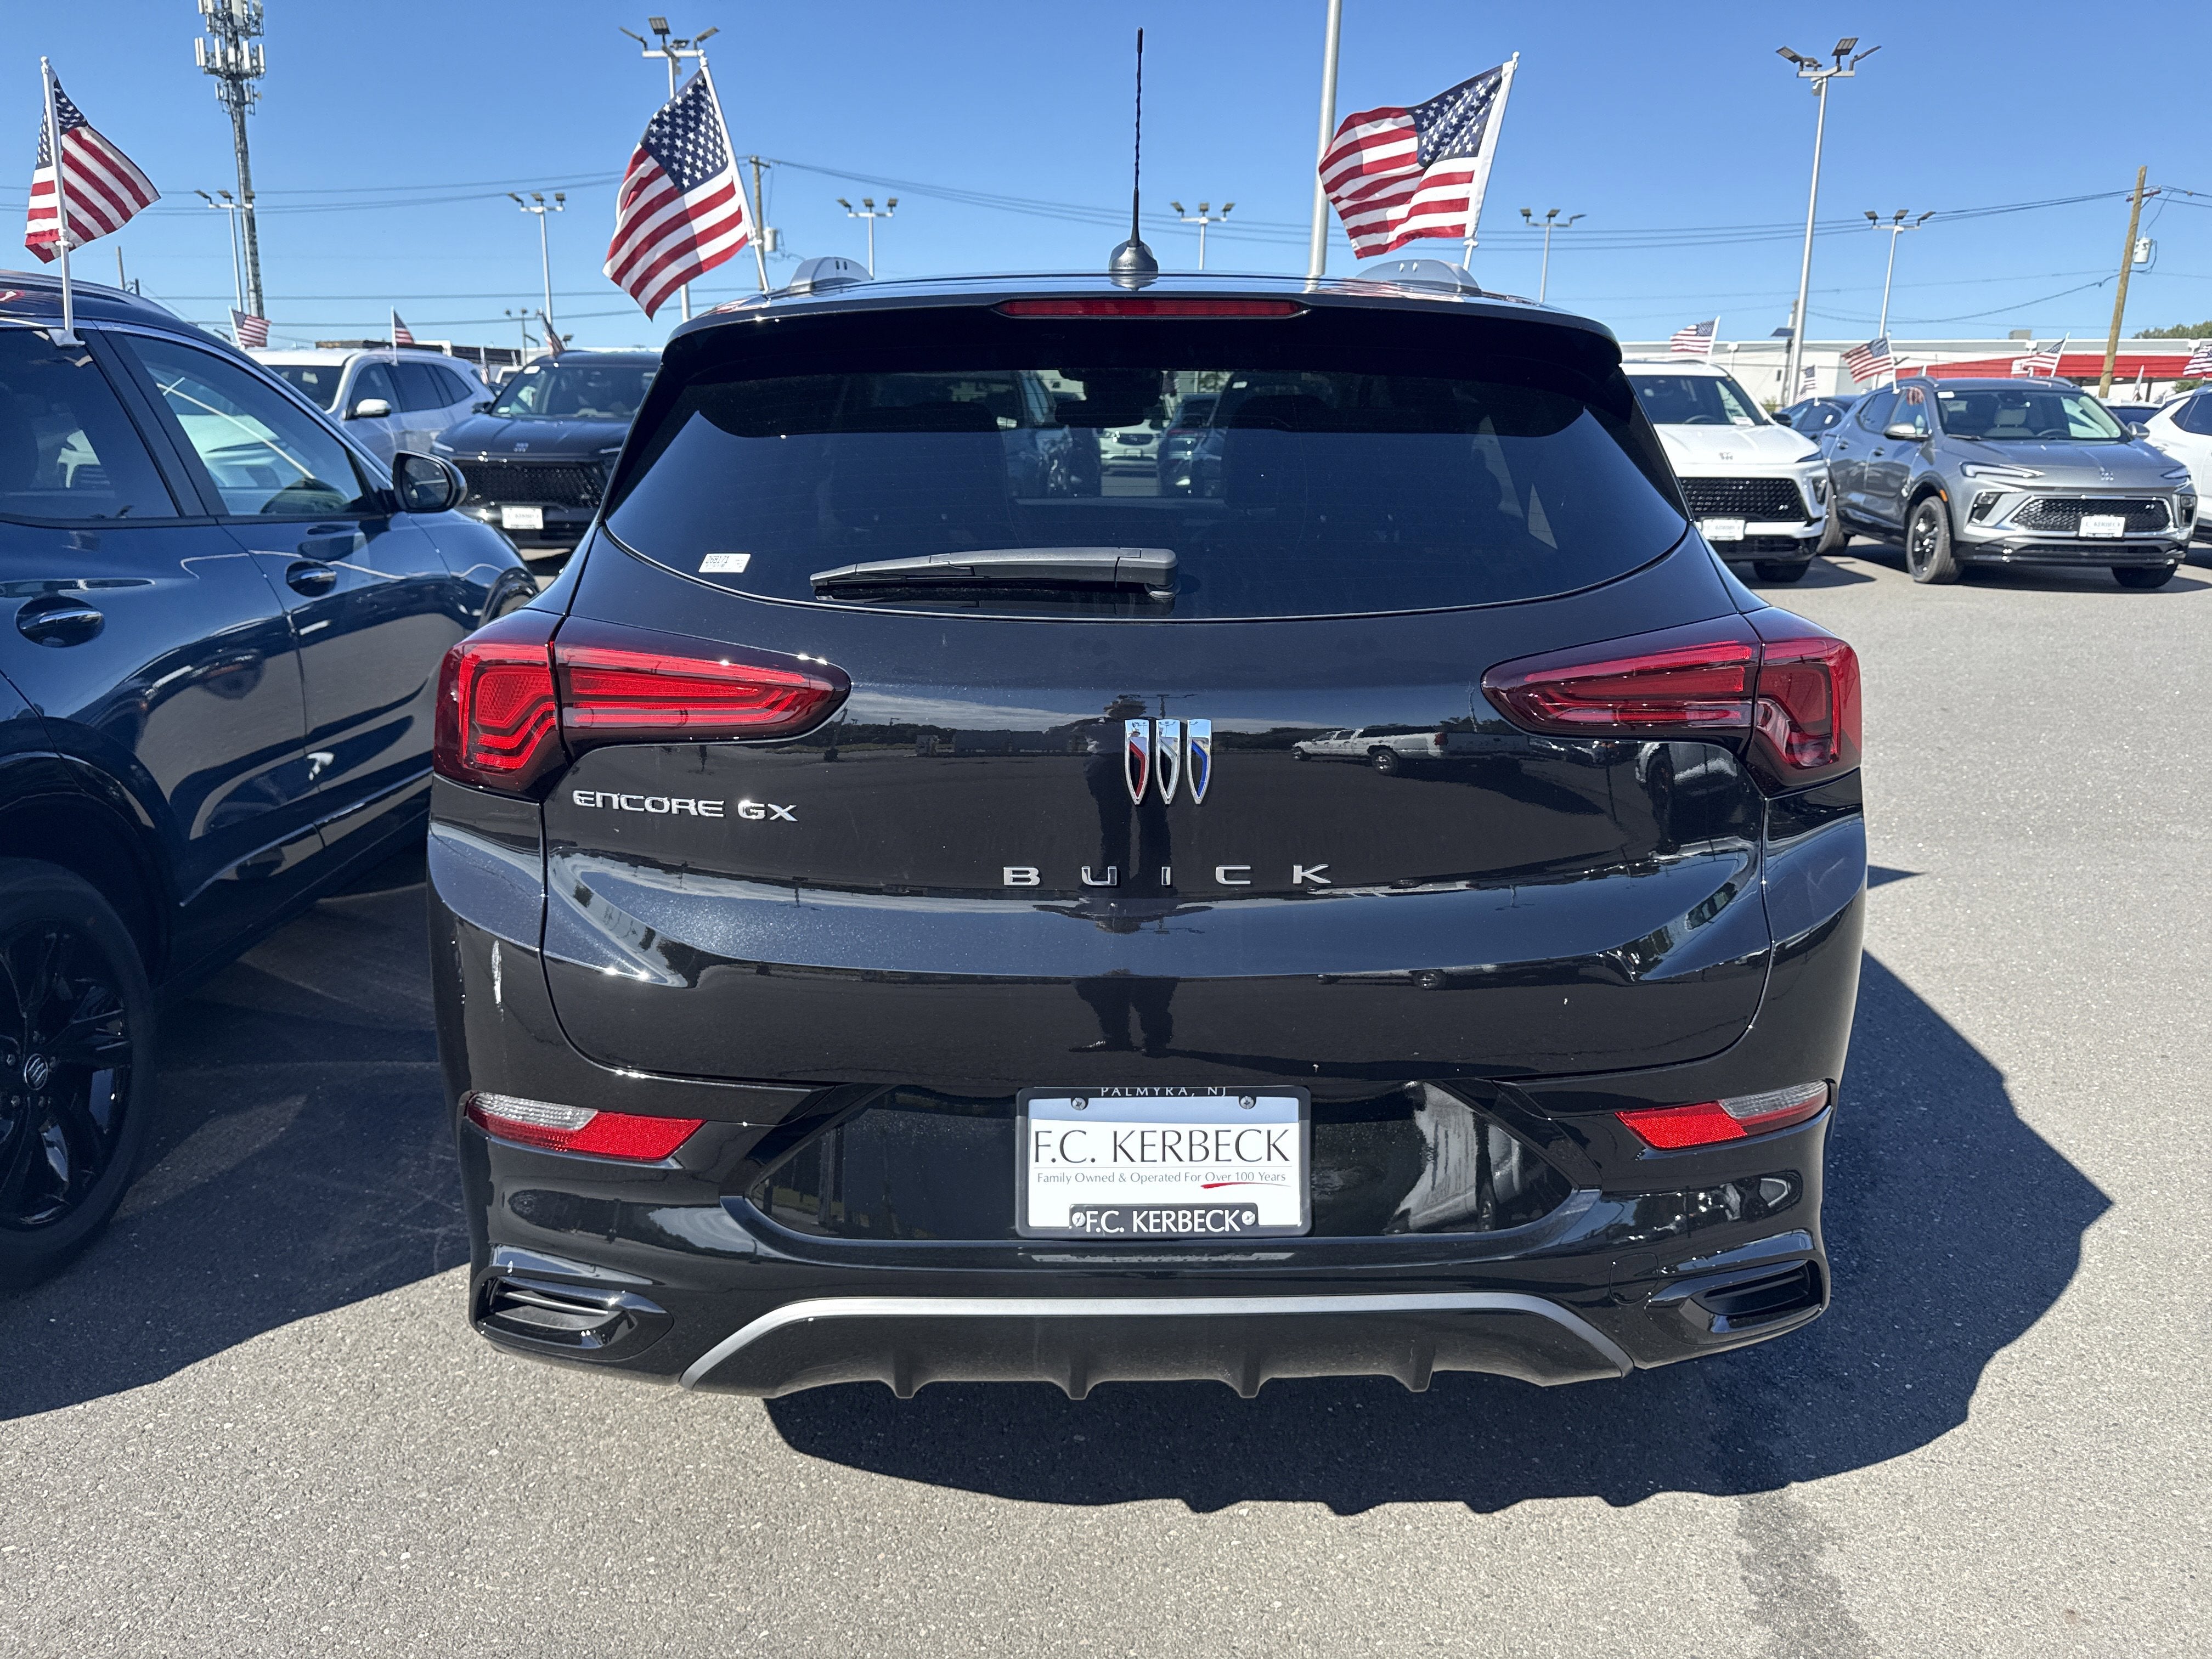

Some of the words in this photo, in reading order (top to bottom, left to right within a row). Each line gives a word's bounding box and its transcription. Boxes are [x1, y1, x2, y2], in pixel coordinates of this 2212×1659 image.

[573, 790, 725, 818] ENCORE
[738, 799, 798, 821] GX
[1003, 864, 1331, 886] BUICK
[1101, 1087, 1195, 1097] PALMYRA,
[1207, 1086, 1226, 1097] NJ
[1035, 1130, 1096, 1163] F.C.
[1113, 1129, 1290, 1163] KERBECK
[1037, 1172, 1072, 1184] Family
[1075, 1172, 1115, 1183] Owned
[1118, 1172, 1126, 1182] &
[1130, 1171, 1181, 1184] Operated
[1184, 1172, 1201, 1182] For
[1205, 1172, 1232, 1182] Over
[1235, 1172, 1255, 1181] 100
[1259, 1172, 1286, 1181] Years
[1086, 1211, 1125, 1233] F.C.
[1132, 1209, 1242, 1233] KERBECK
